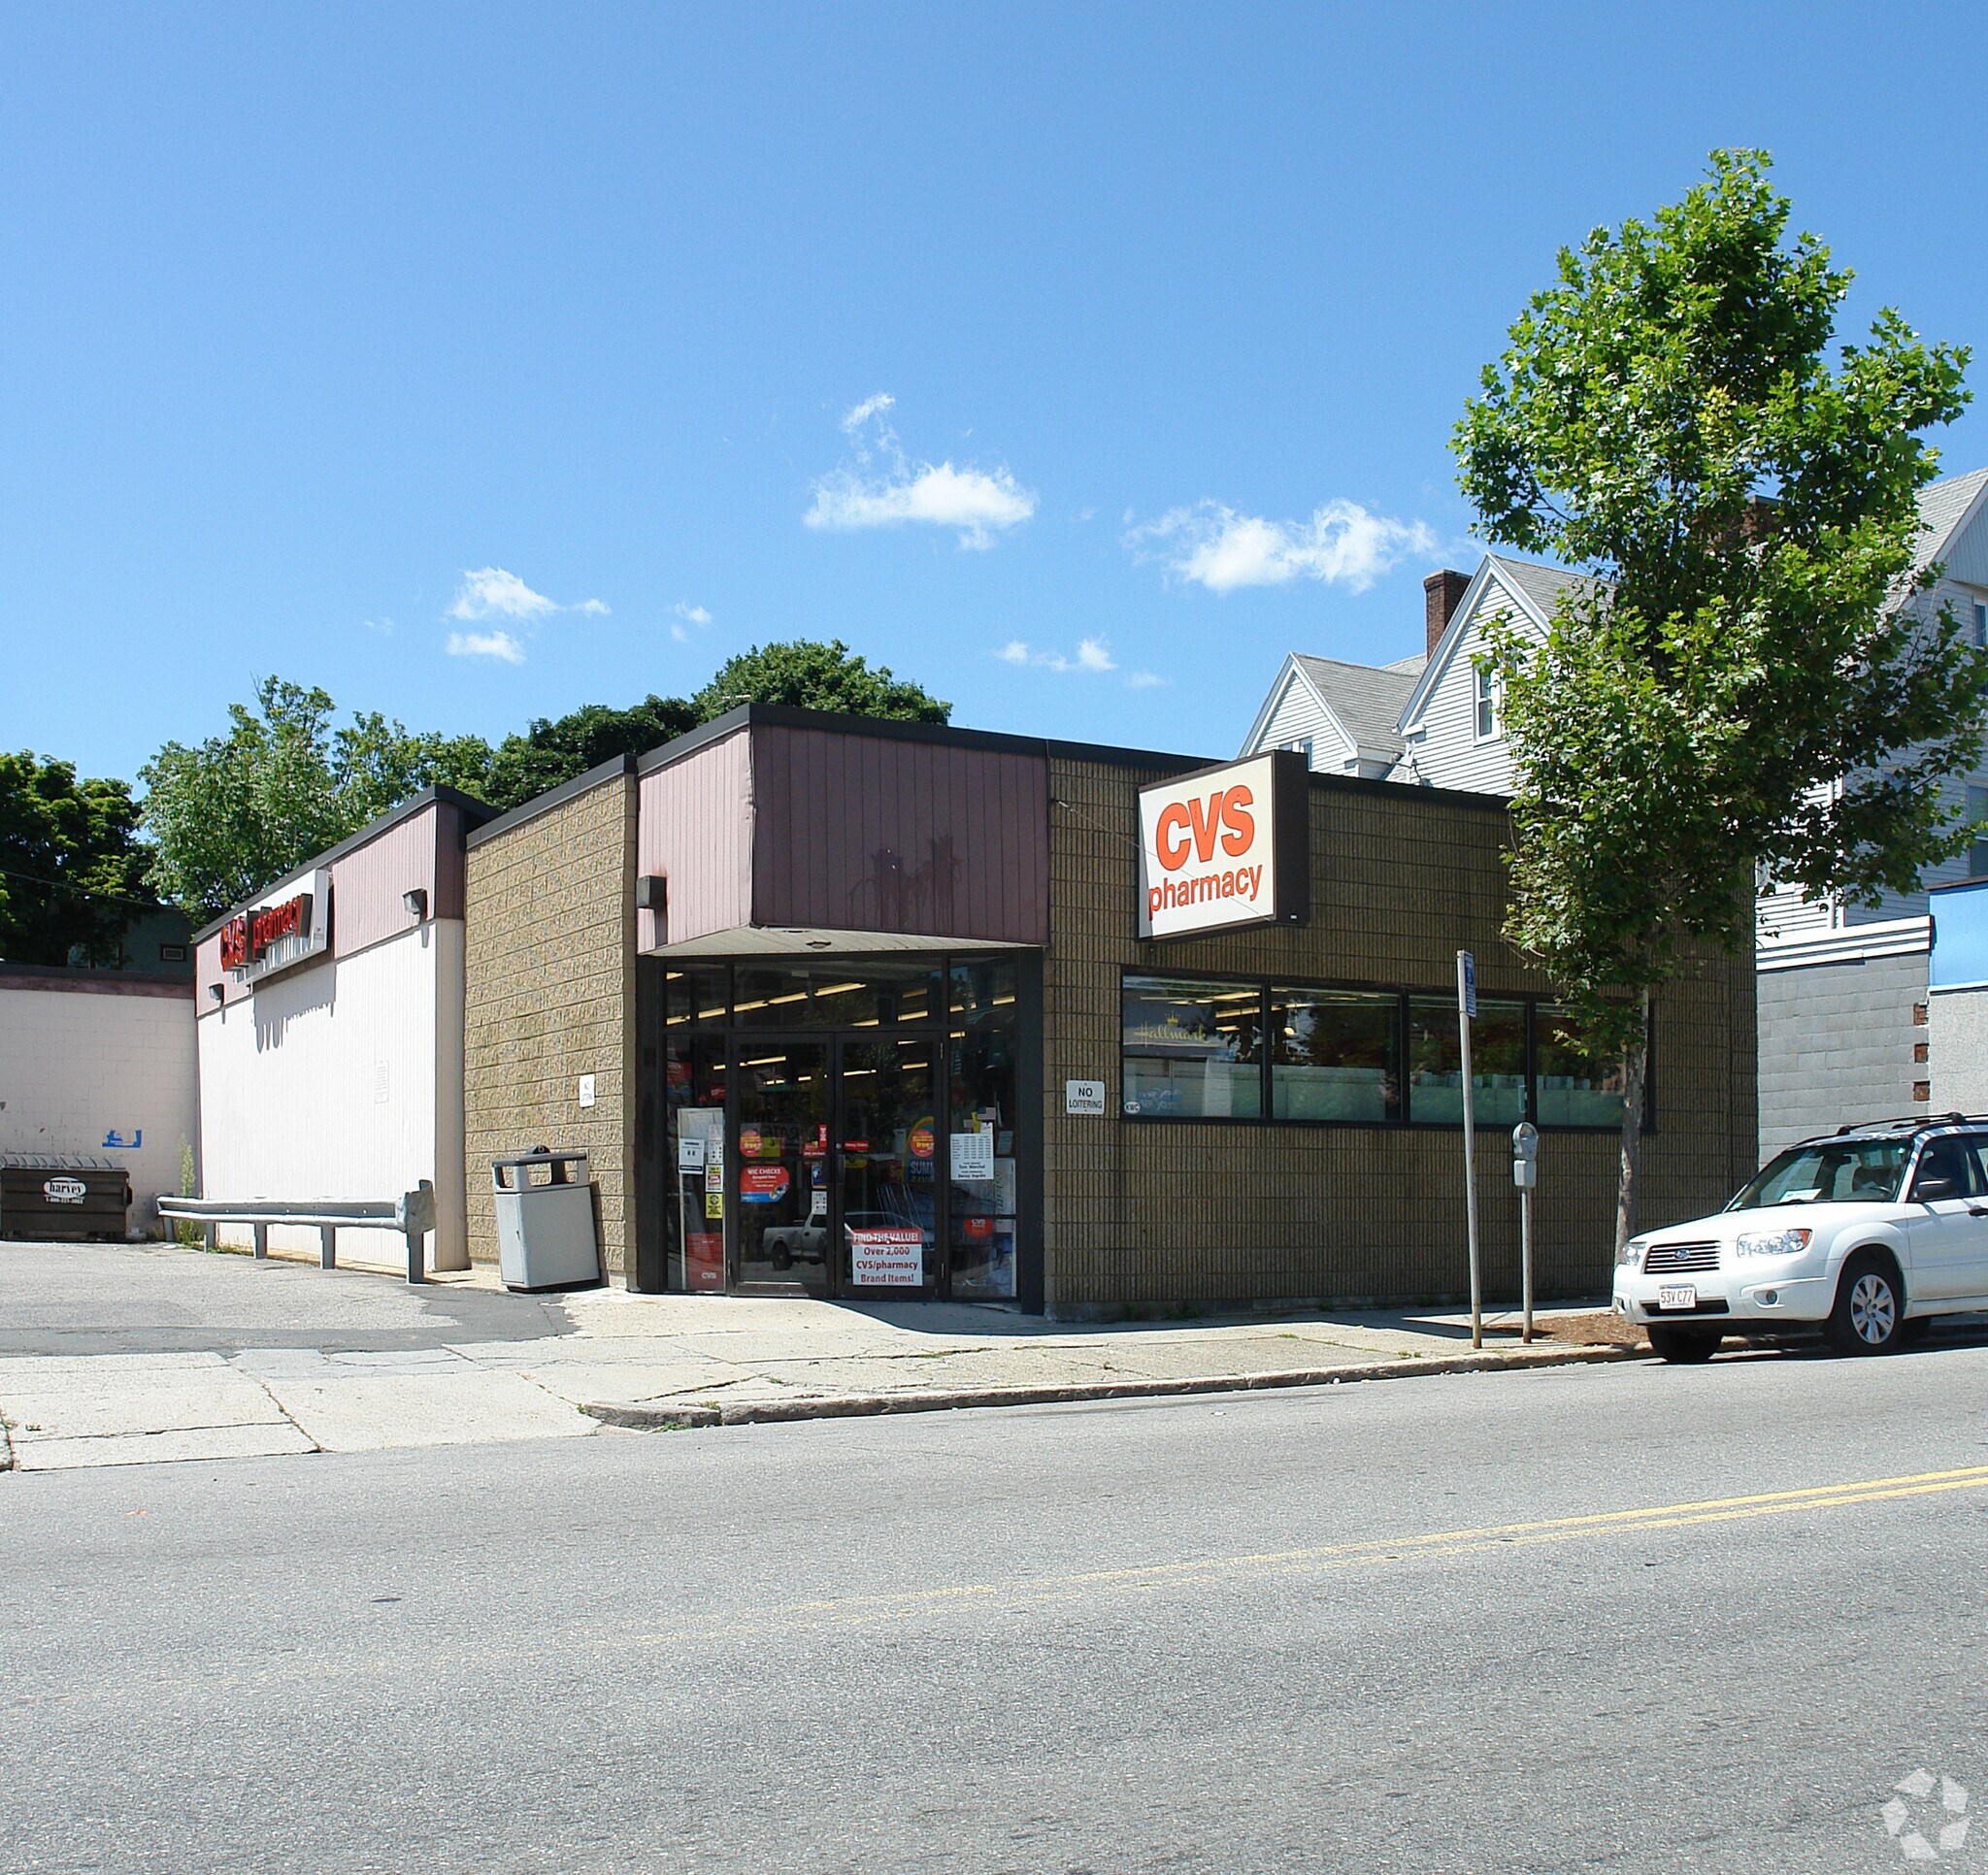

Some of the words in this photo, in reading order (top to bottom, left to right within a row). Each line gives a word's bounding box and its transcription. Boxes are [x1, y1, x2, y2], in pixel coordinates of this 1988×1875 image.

[1155, 784, 1255, 872] CVS
[1148, 864, 1263, 921] pharmacy
[1134, 1020, 1210, 1047] Hallmark
[1077, 1087, 1093, 1098] NO
[1069, 1099, 1103, 1109] LOITERING
[50, 1180, 82, 1196] harvey
[853, 1233, 873, 1242] FIND
[874, 1233, 888, 1242] THE
[864, 1247, 884, 1256] Over
[885, 1246, 910, 1256] 2,000
[856, 1260, 918, 1271] CVS/pharmacy
[860, 1273, 886, 1283] Brand
[887, 1273, 914, 1283] Items!
